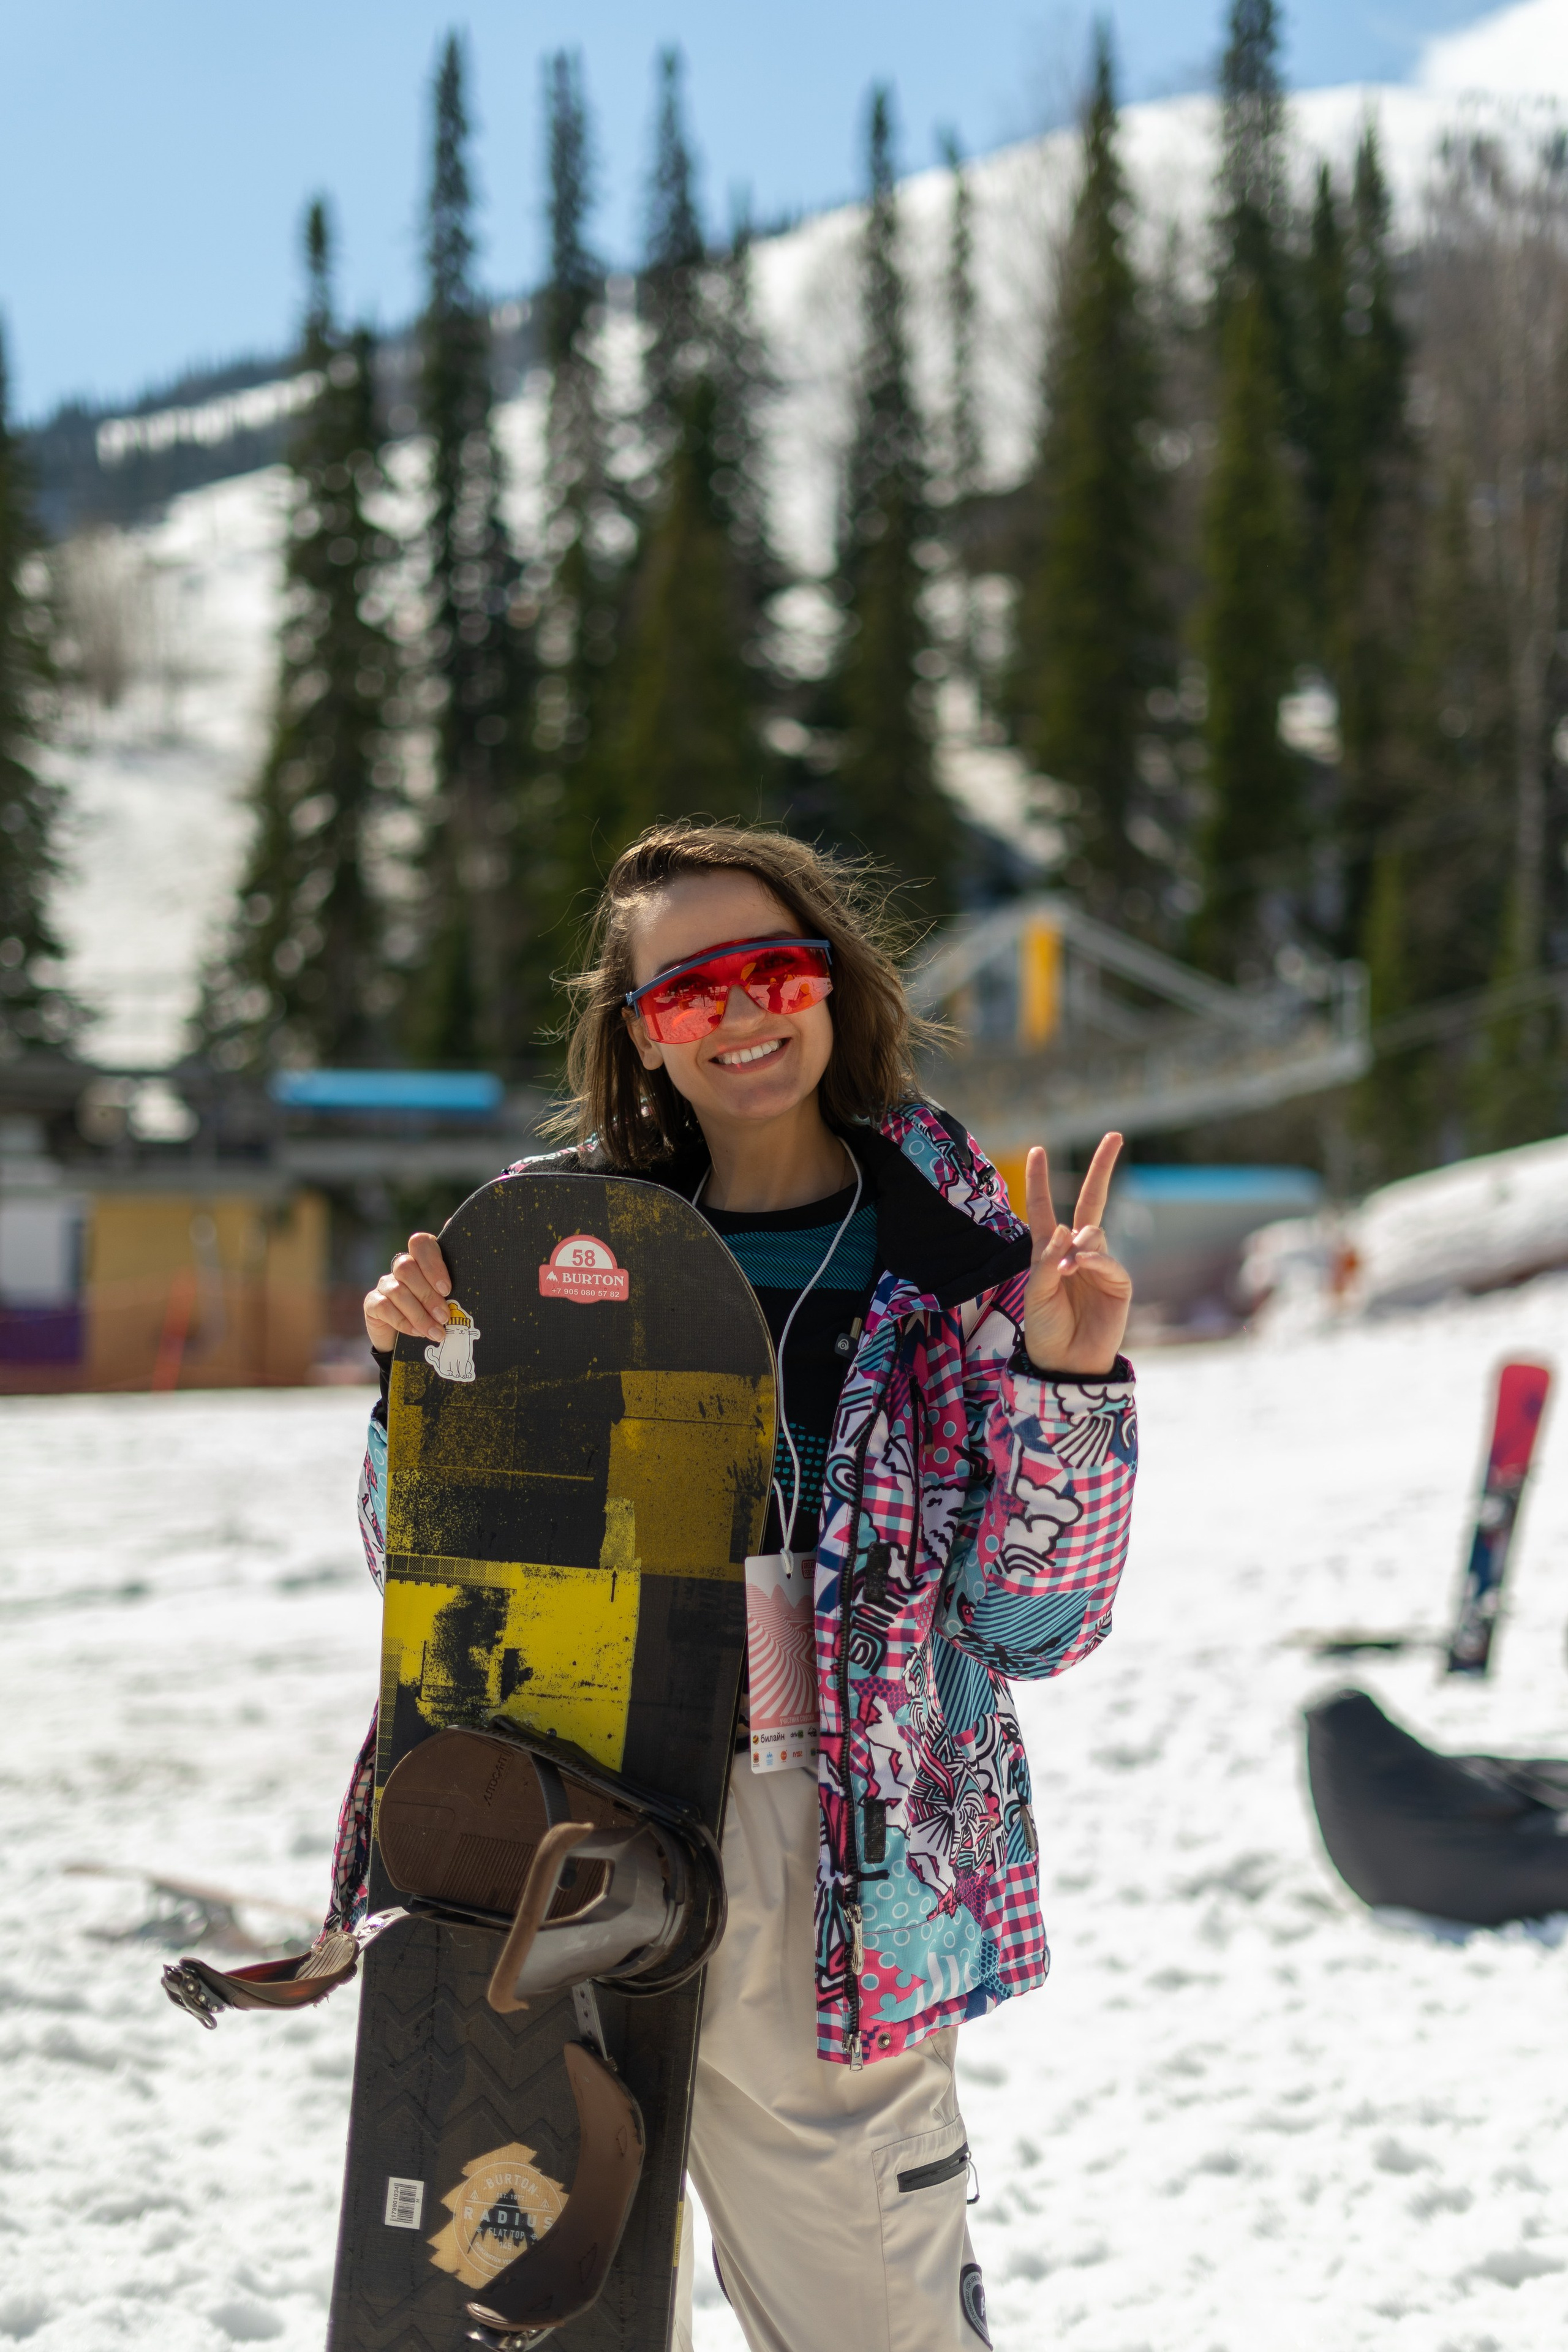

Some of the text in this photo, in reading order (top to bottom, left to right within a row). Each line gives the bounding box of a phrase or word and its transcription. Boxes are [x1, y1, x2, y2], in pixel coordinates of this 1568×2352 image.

[572, 1249, 596, 1267] 58
[562, 1272, 624, 1286] BURTON
[779, 1716, 799, 1725] УЧАСТНИК
[761, 1732, 785, 1743] билайн
[464, 2206, 554, 2230] RADIUS
[489, 2227, 525, 2239] FLAT TOP
